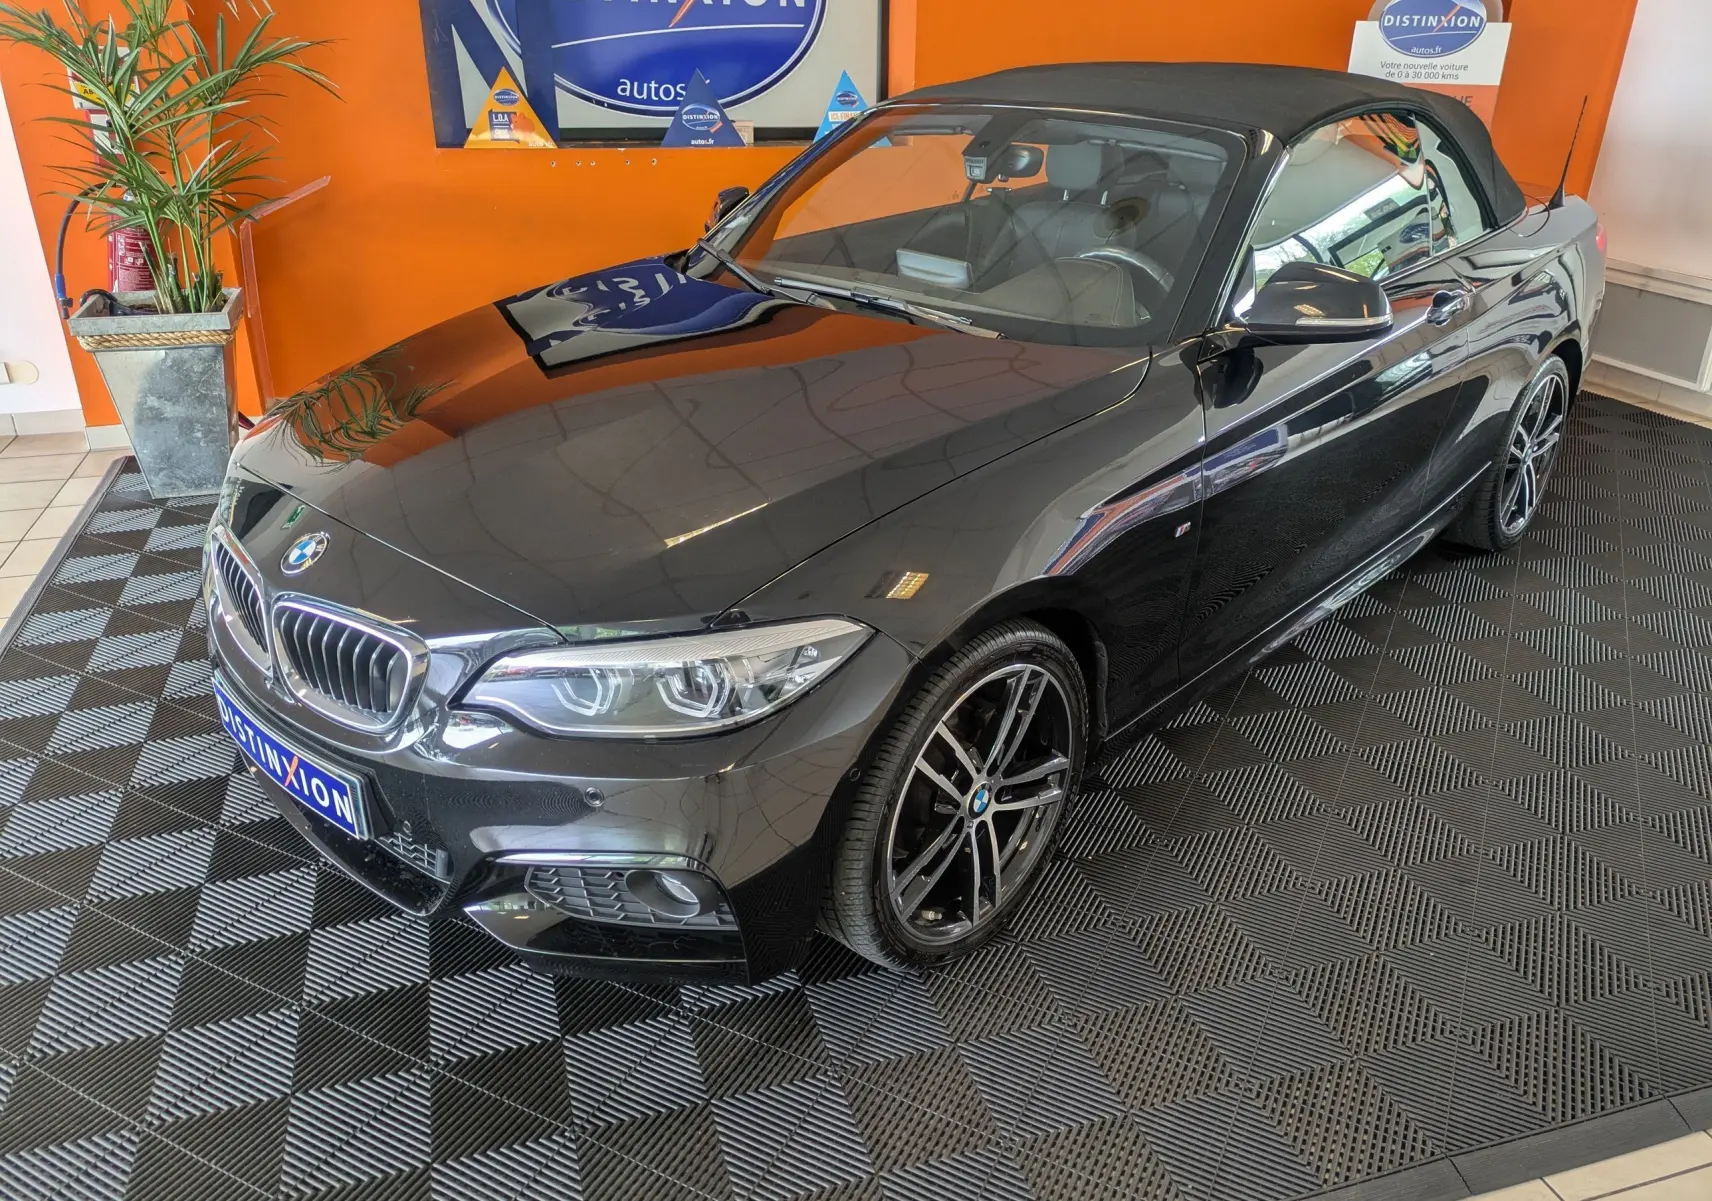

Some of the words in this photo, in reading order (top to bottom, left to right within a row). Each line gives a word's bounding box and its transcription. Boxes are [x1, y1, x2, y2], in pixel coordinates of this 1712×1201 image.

[1384, 14, 1481, 28] DISTINXION
[1410, 46, 1442, 54] autos.fr
[1380, 61, 1402, 69] Votre
[1403, 62, 1438, 71] nouvelle
[1440, 63, 1469, 71] voiture
[1385, 70, 1396, 78] de
[1397, 71, 1402, 79] 0
[1404, 71, 1410, 79] à
[1411, 71, 1422, 79] 30
[1423, 72, 1440, 80] 000
[1441, 71, 1460, 80] kms
[617, 78, 710, 101] autos
[217, 693, 353, 825] DISTINXION
